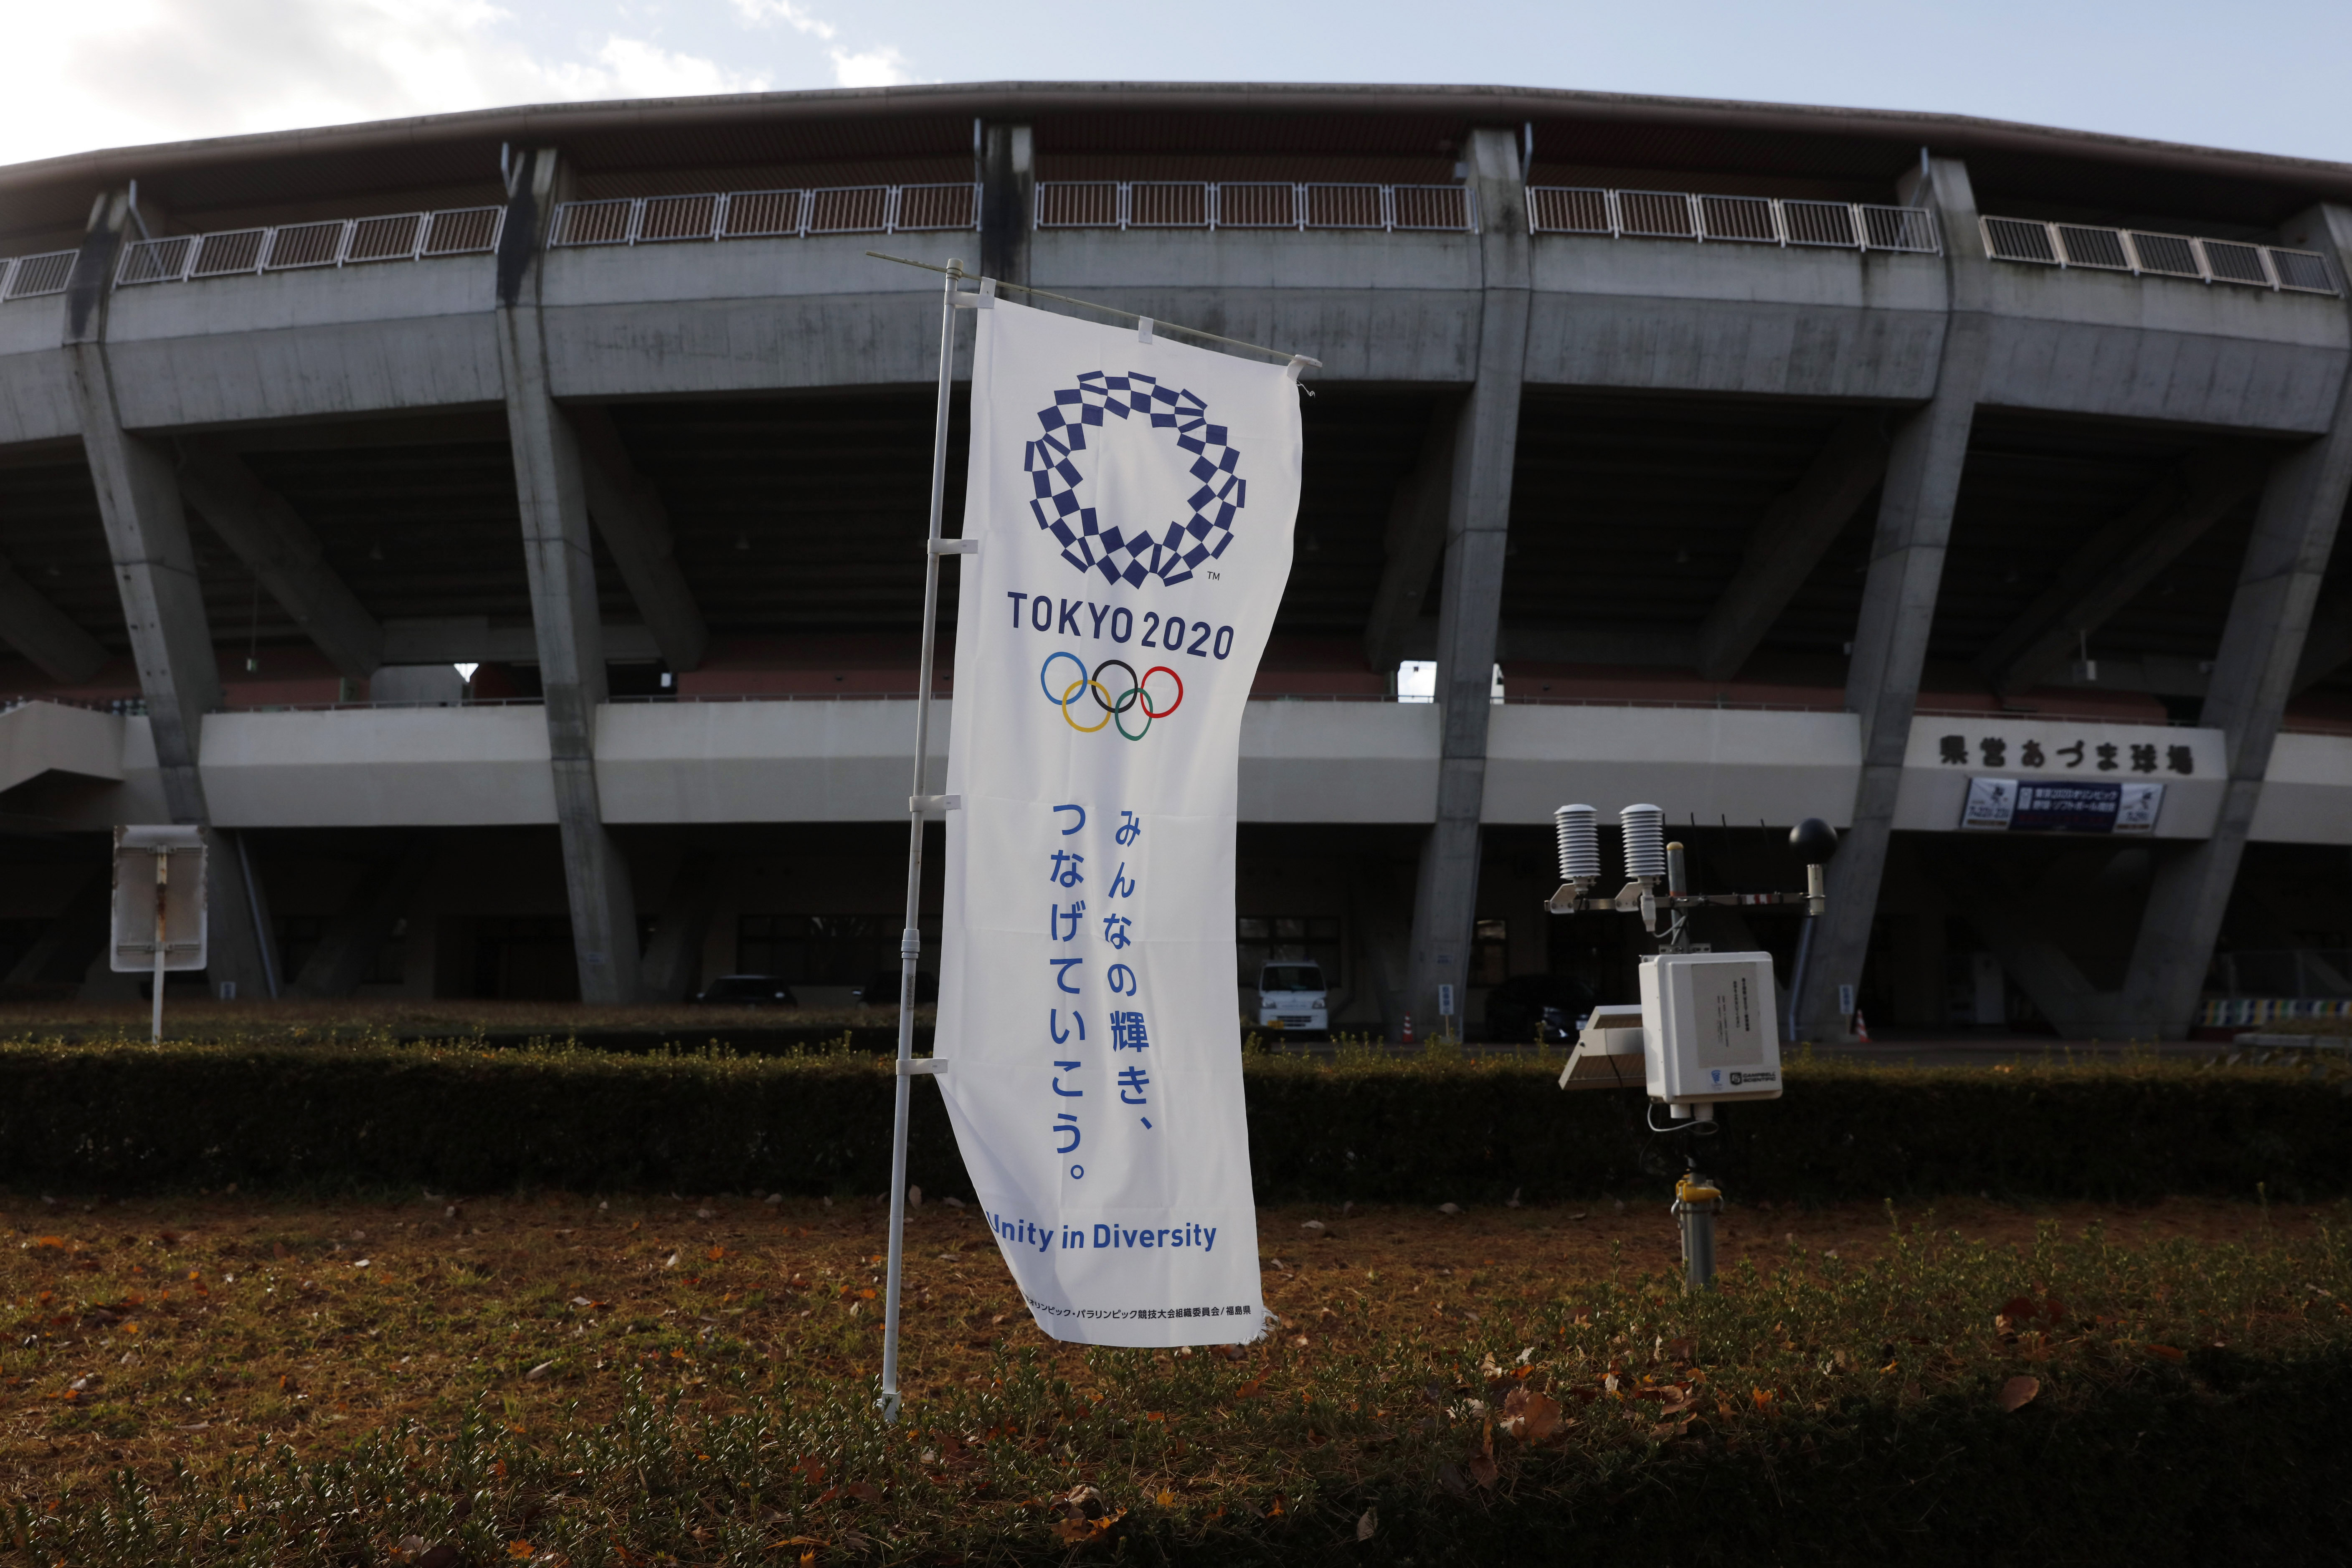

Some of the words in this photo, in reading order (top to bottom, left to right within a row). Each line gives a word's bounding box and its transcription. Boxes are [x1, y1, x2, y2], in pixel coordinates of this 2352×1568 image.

[1207, 571, 1220, 581] TM
[1007, 591, 1133, 643] TOKYO
[1141, 611, 1234, 660] 2020
[1940, 735, 2193, 774] 県営あづま球場
[1049, 804, 1086, 1180] つなげていこう。
[1102, 811, 1153, 1130] みんなの輝き、
[986, 1211, 1054, 1252] Unity
[1061, 1224, 1085, 1249] in
[1093, 1222, 1217, 1252] Diversity
